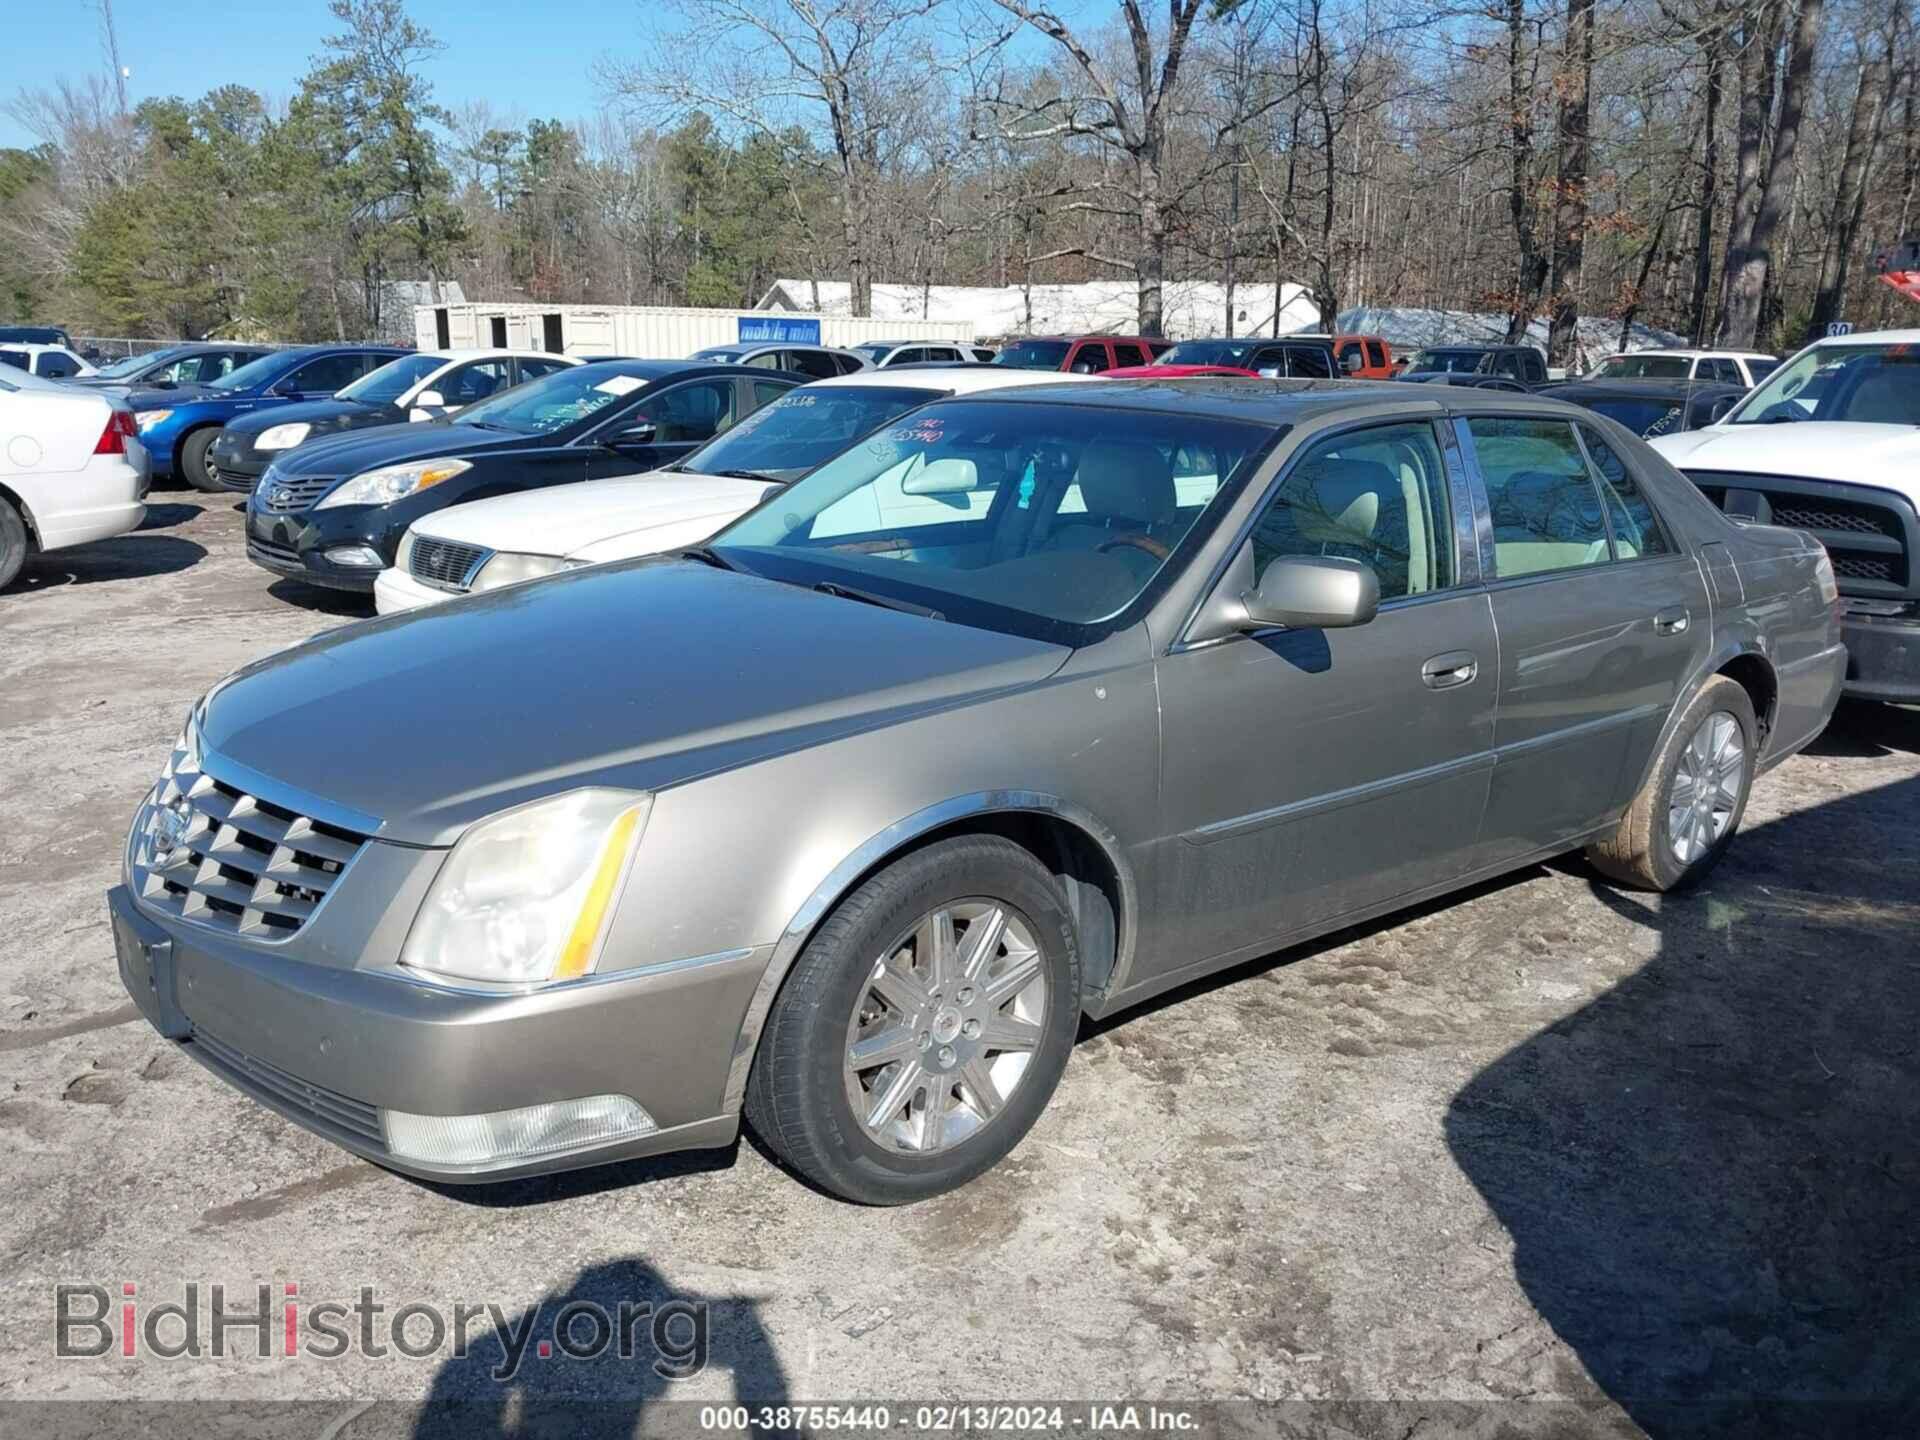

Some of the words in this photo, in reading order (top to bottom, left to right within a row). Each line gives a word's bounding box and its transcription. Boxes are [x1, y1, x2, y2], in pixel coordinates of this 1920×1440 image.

[741, 320, 787, 340] mobile
[788, 324, 819, 341] mini
[1831, 324, 1850, 337] 30
